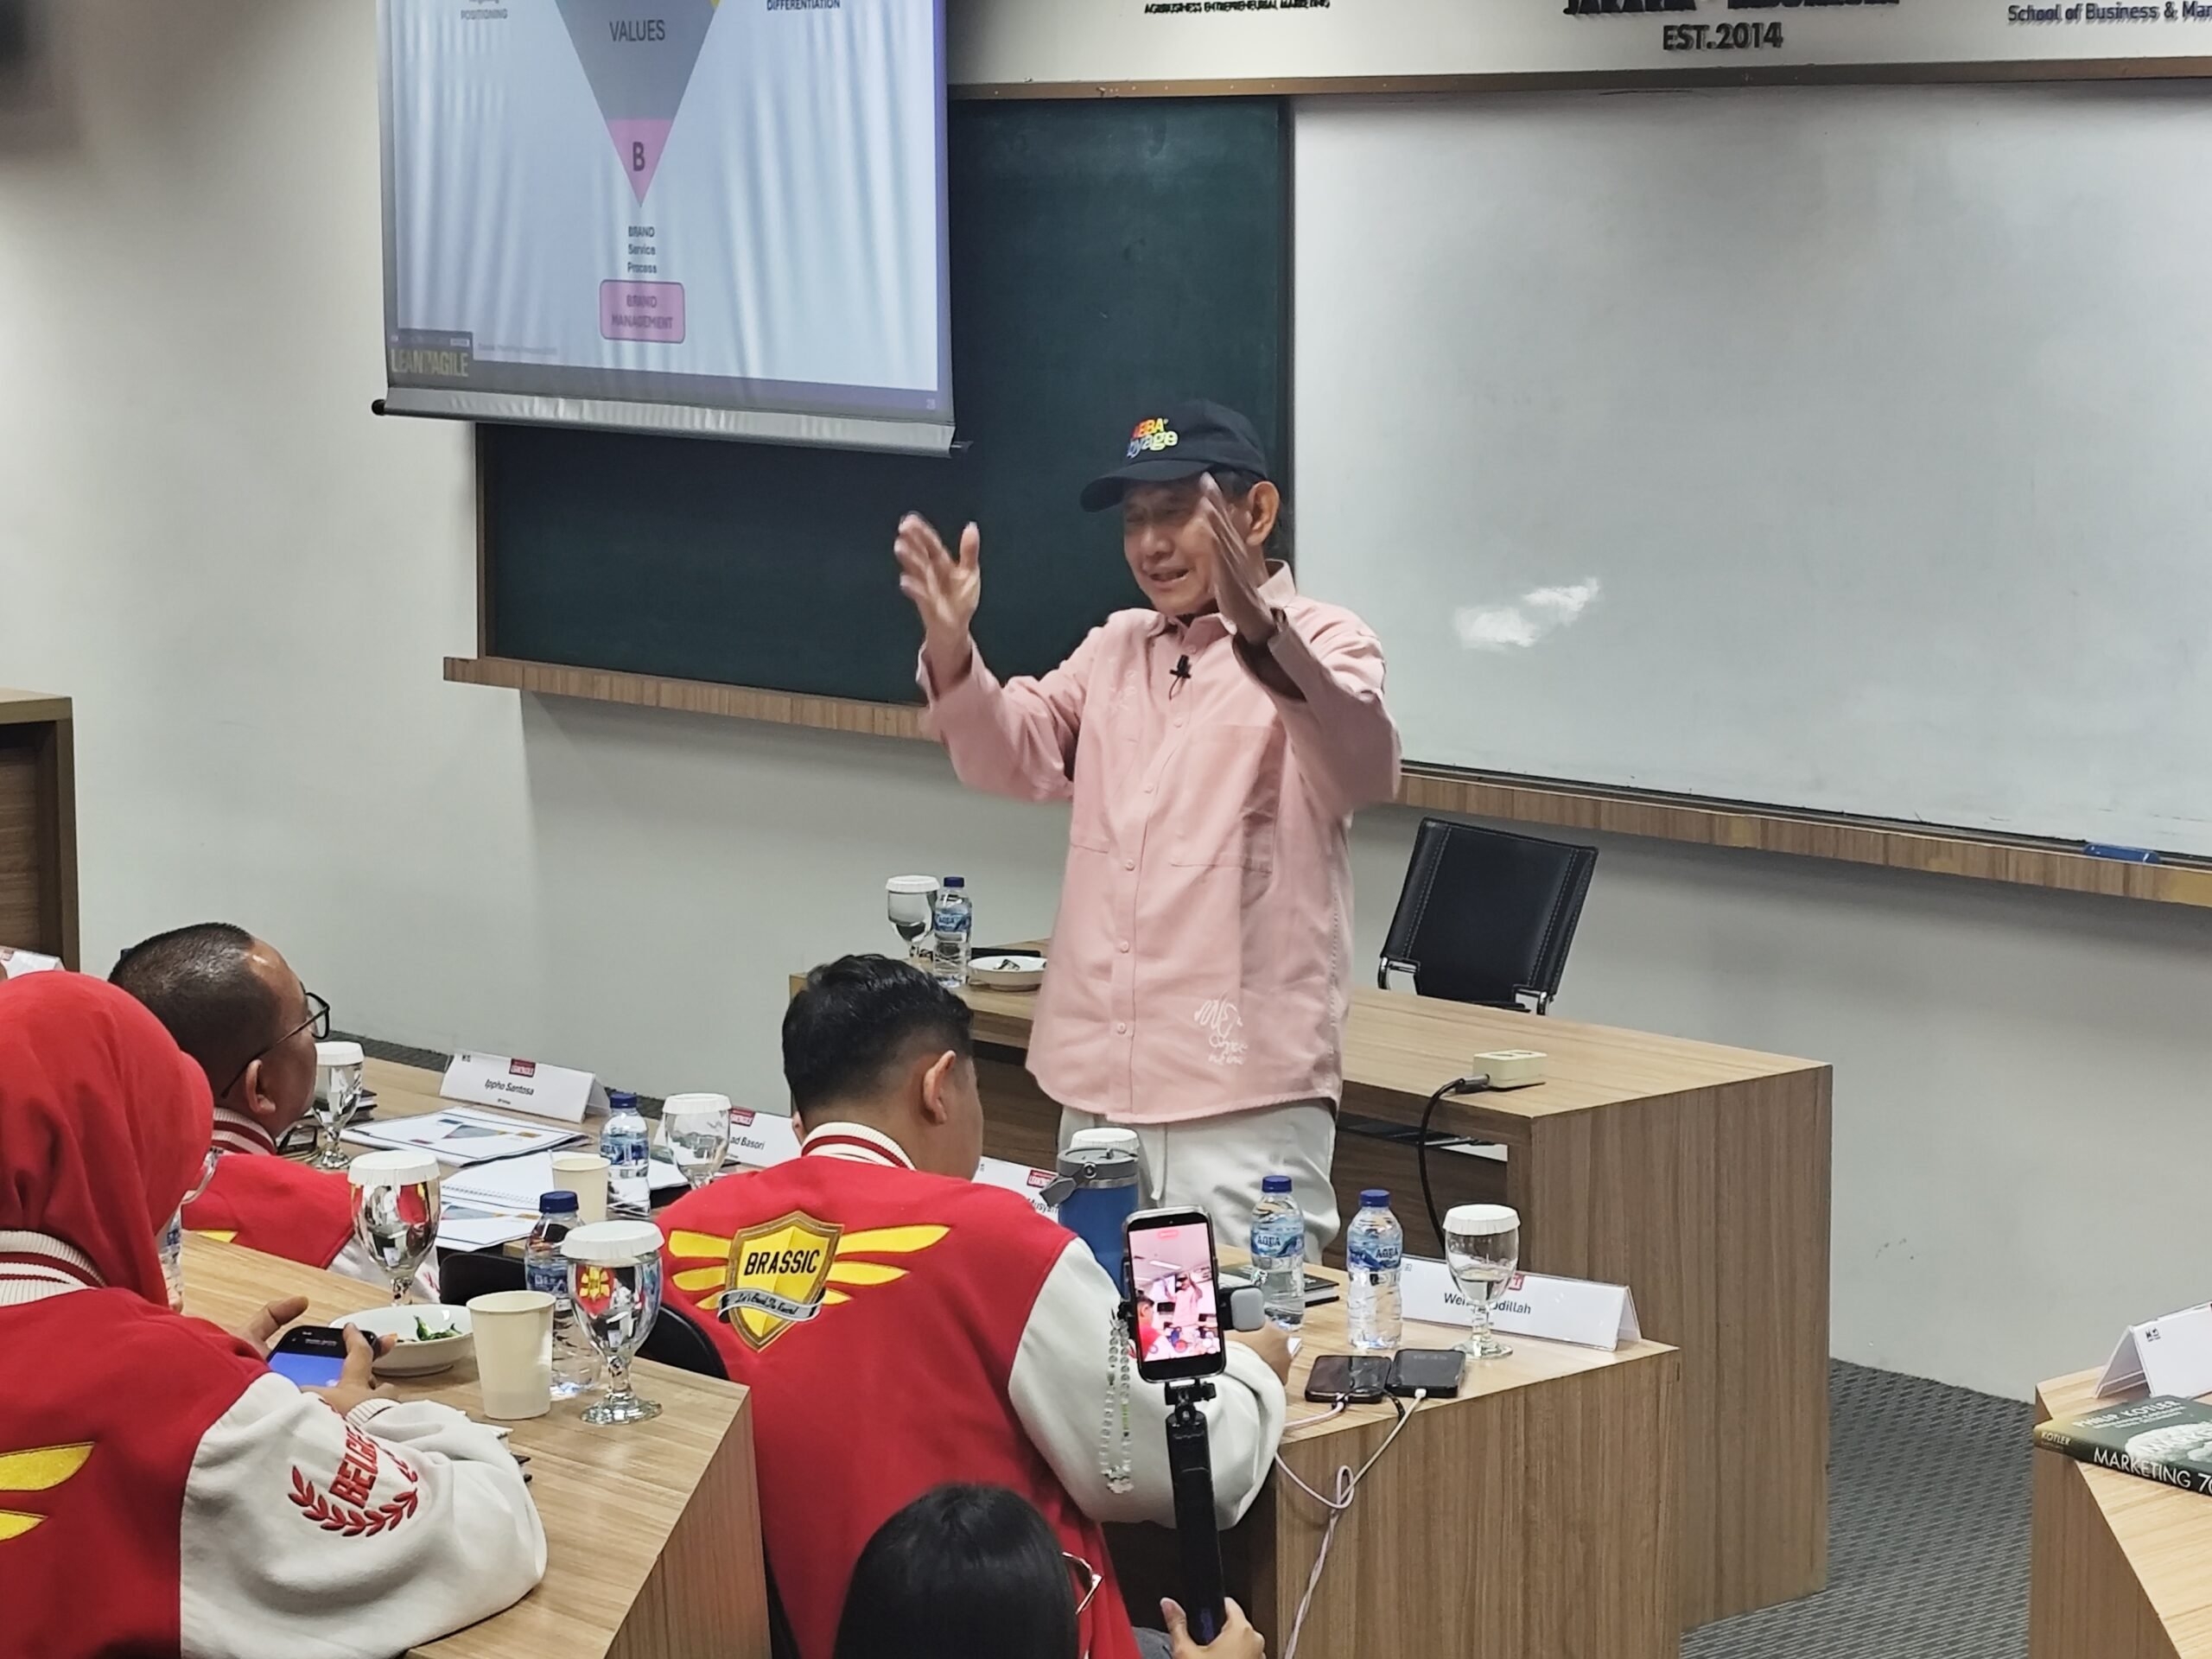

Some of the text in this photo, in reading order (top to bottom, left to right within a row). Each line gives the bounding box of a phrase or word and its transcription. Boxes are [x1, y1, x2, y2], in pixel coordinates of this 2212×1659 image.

[2008, 4, 2061, 22] School
[2065, 3, 2082, 21] of
[2086, 3, 2159, 20] Business
[2164, 1, 2177, 19] &
[609, 19, 666, 41] VALUES
[1663, 22, 1783, 50] EST.2014
[632, 142, 645, 171] B
[628, 226, 655, 238] BRAND
[628, 244, 656, 255] Service
[627, 262, 657, 273] Process
[626, 295, 657, 308] BRAND
[611, 314, 673, 329] MANAGEMENT
[505, 1082, 535, 1096] Santosa
[741, 1136, 766, 1150] Basori
[1257, 1236, 1281, 1248] AQUA
[1376, 1247, 1399, 1260] AQUA
[744, 1249, 821, 1276] BRASSIC
[2041, 1431, 2071, 1446] KOTLER
[2094, 1446, 2191, 1488] MARKETING
